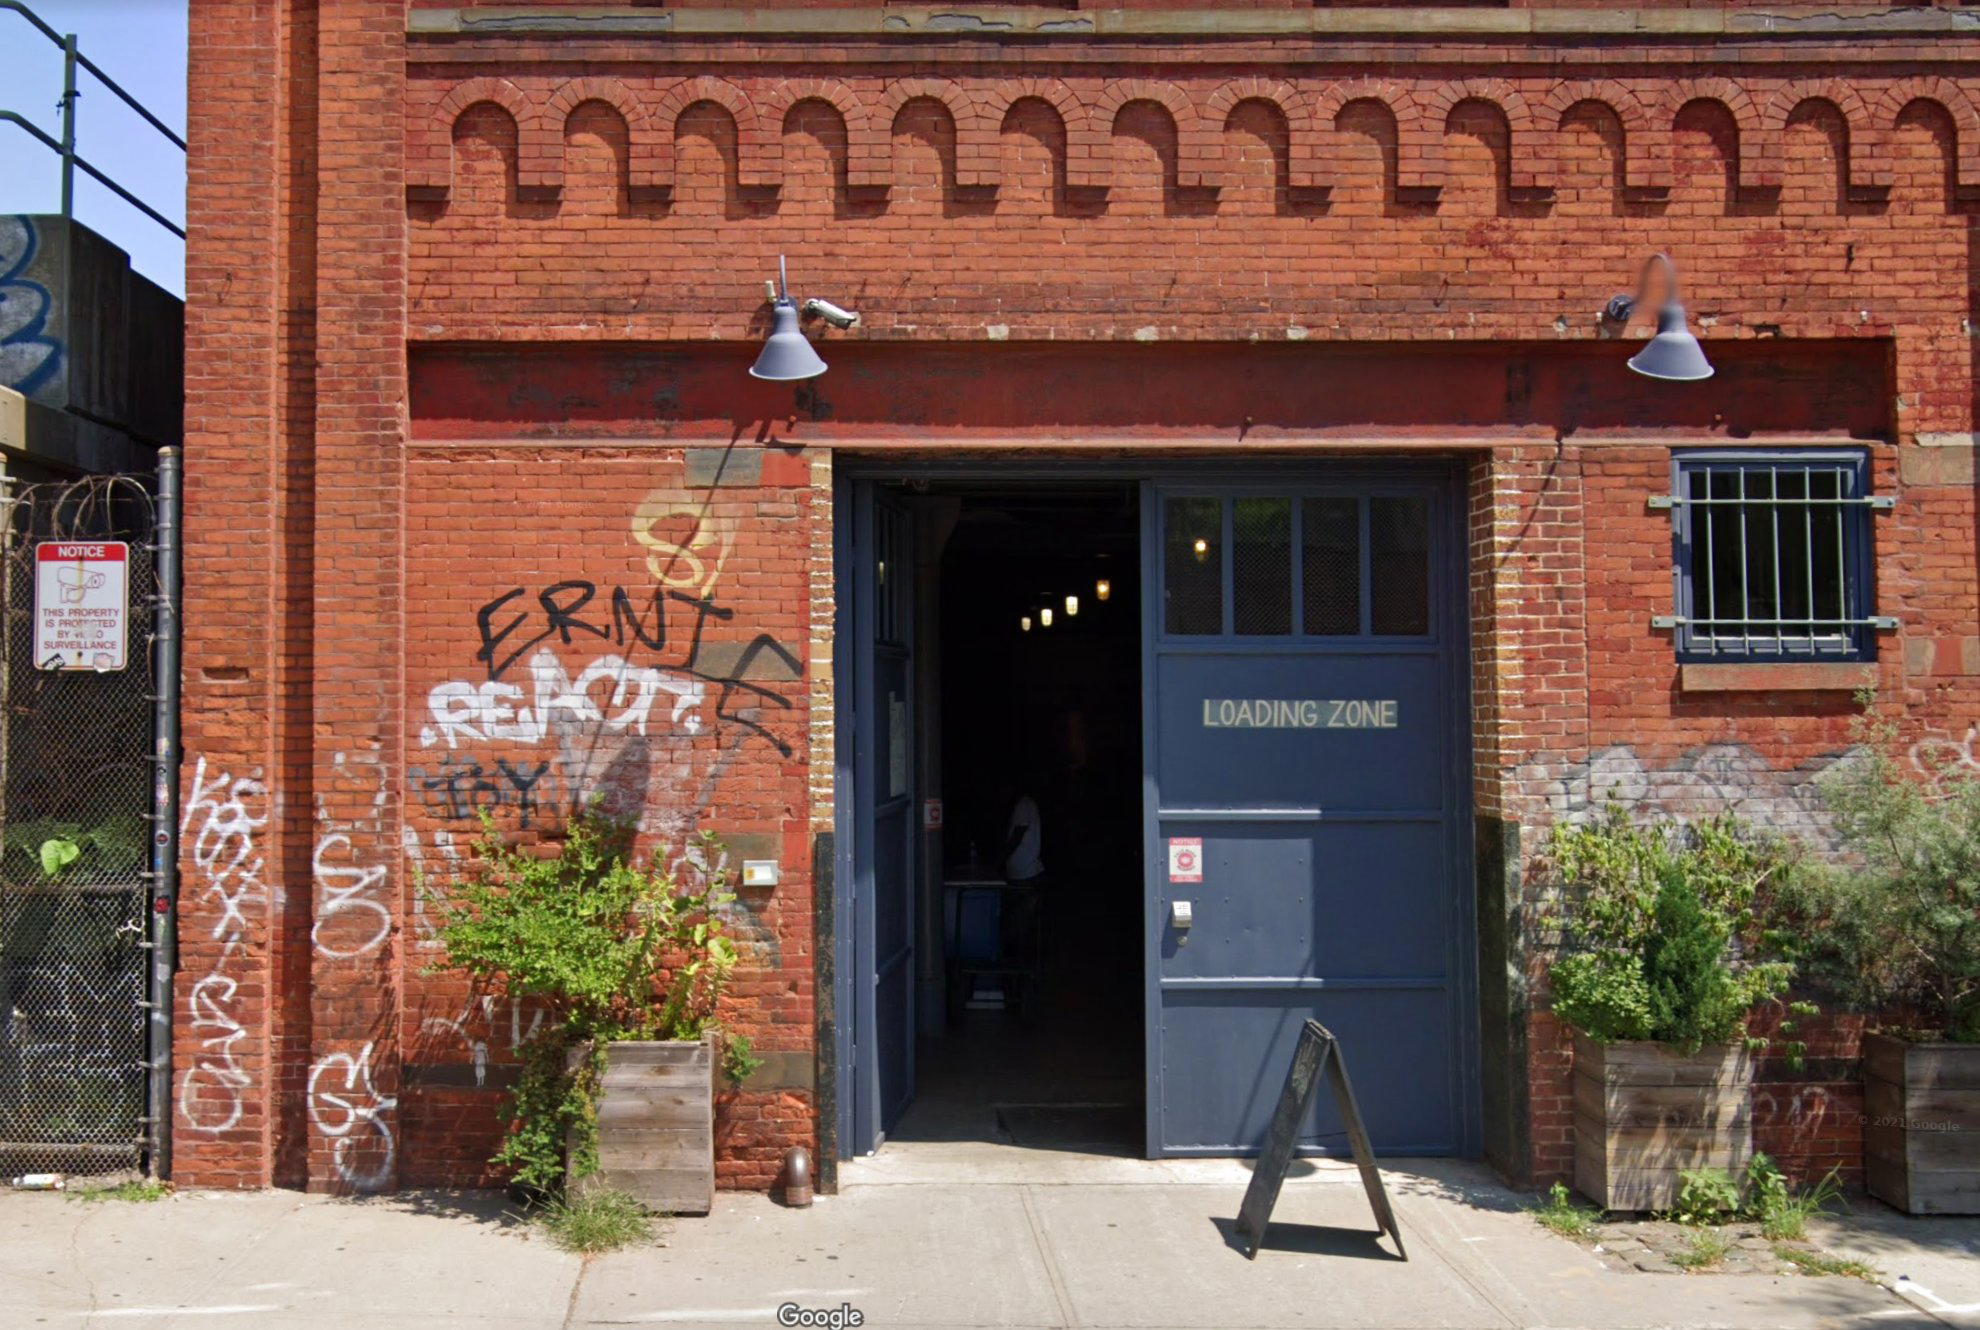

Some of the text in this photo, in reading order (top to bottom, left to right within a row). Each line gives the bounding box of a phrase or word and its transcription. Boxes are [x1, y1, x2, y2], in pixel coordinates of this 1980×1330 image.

[58, 546, 105, 557] NOTICE
[43, 608, 119, 617] THIS PROPERTY
[45, 619, 55, 628] IS
[57, 630, 70, 639] BY
[44, 641, 117, 650] SURVEILLANCE
[1203, 699, 1398, 728] LOADING ZONE
